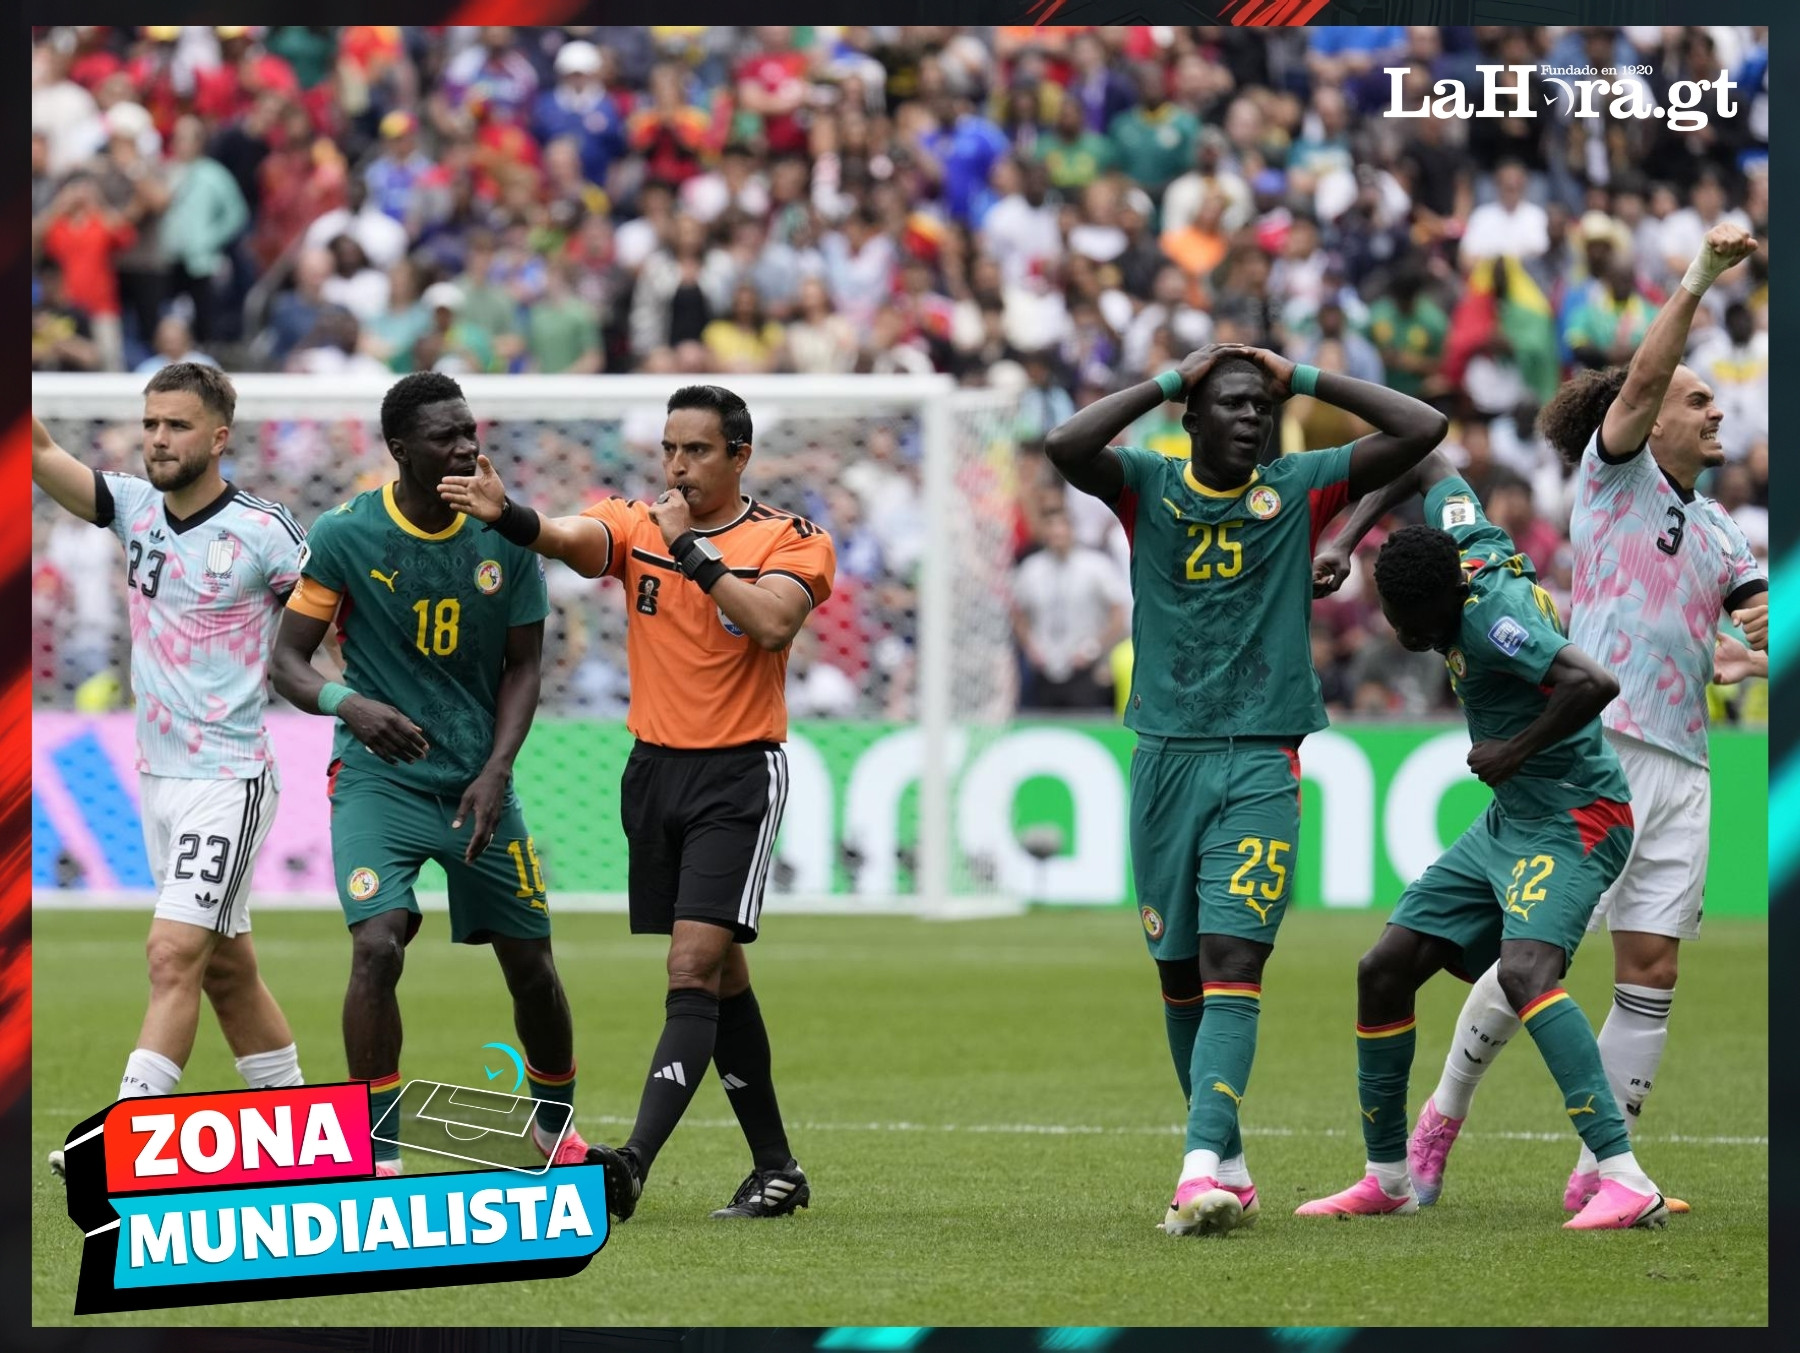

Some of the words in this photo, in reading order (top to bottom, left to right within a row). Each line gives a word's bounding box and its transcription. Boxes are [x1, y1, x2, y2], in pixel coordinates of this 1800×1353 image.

[1186, 519, 1244, 580] 25
[1656, 506, 1686, 556] 3
[128, 539, 167, 599] 23
[412, 598, 461, 656] 18
[174, 833, 231, 884] 23
[1228, 837, 1292, 901] 25
